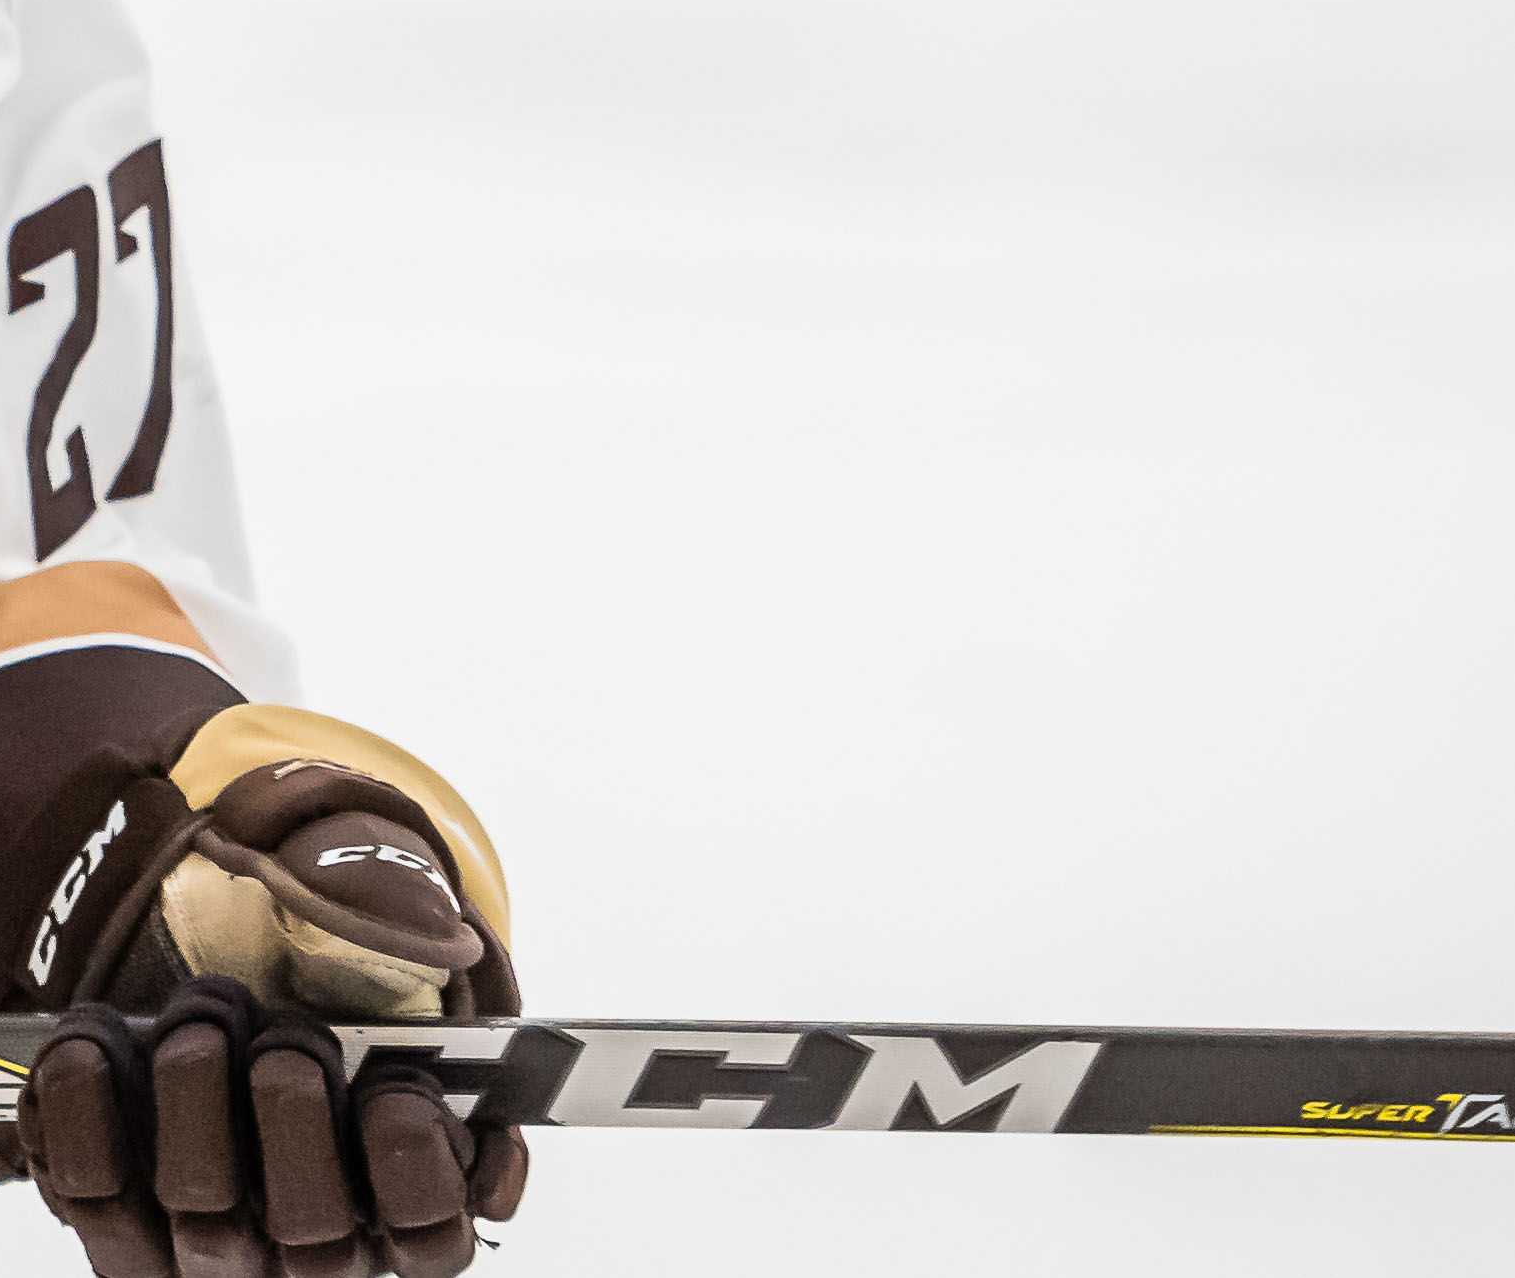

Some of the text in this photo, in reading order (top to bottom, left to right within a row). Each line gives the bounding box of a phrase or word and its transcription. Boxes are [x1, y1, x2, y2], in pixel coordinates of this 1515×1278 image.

[6, 137, 176, 562] 27
[27, 799, 127, 987] CCM
[1300, 1101, 1436, 1123] SUPER
